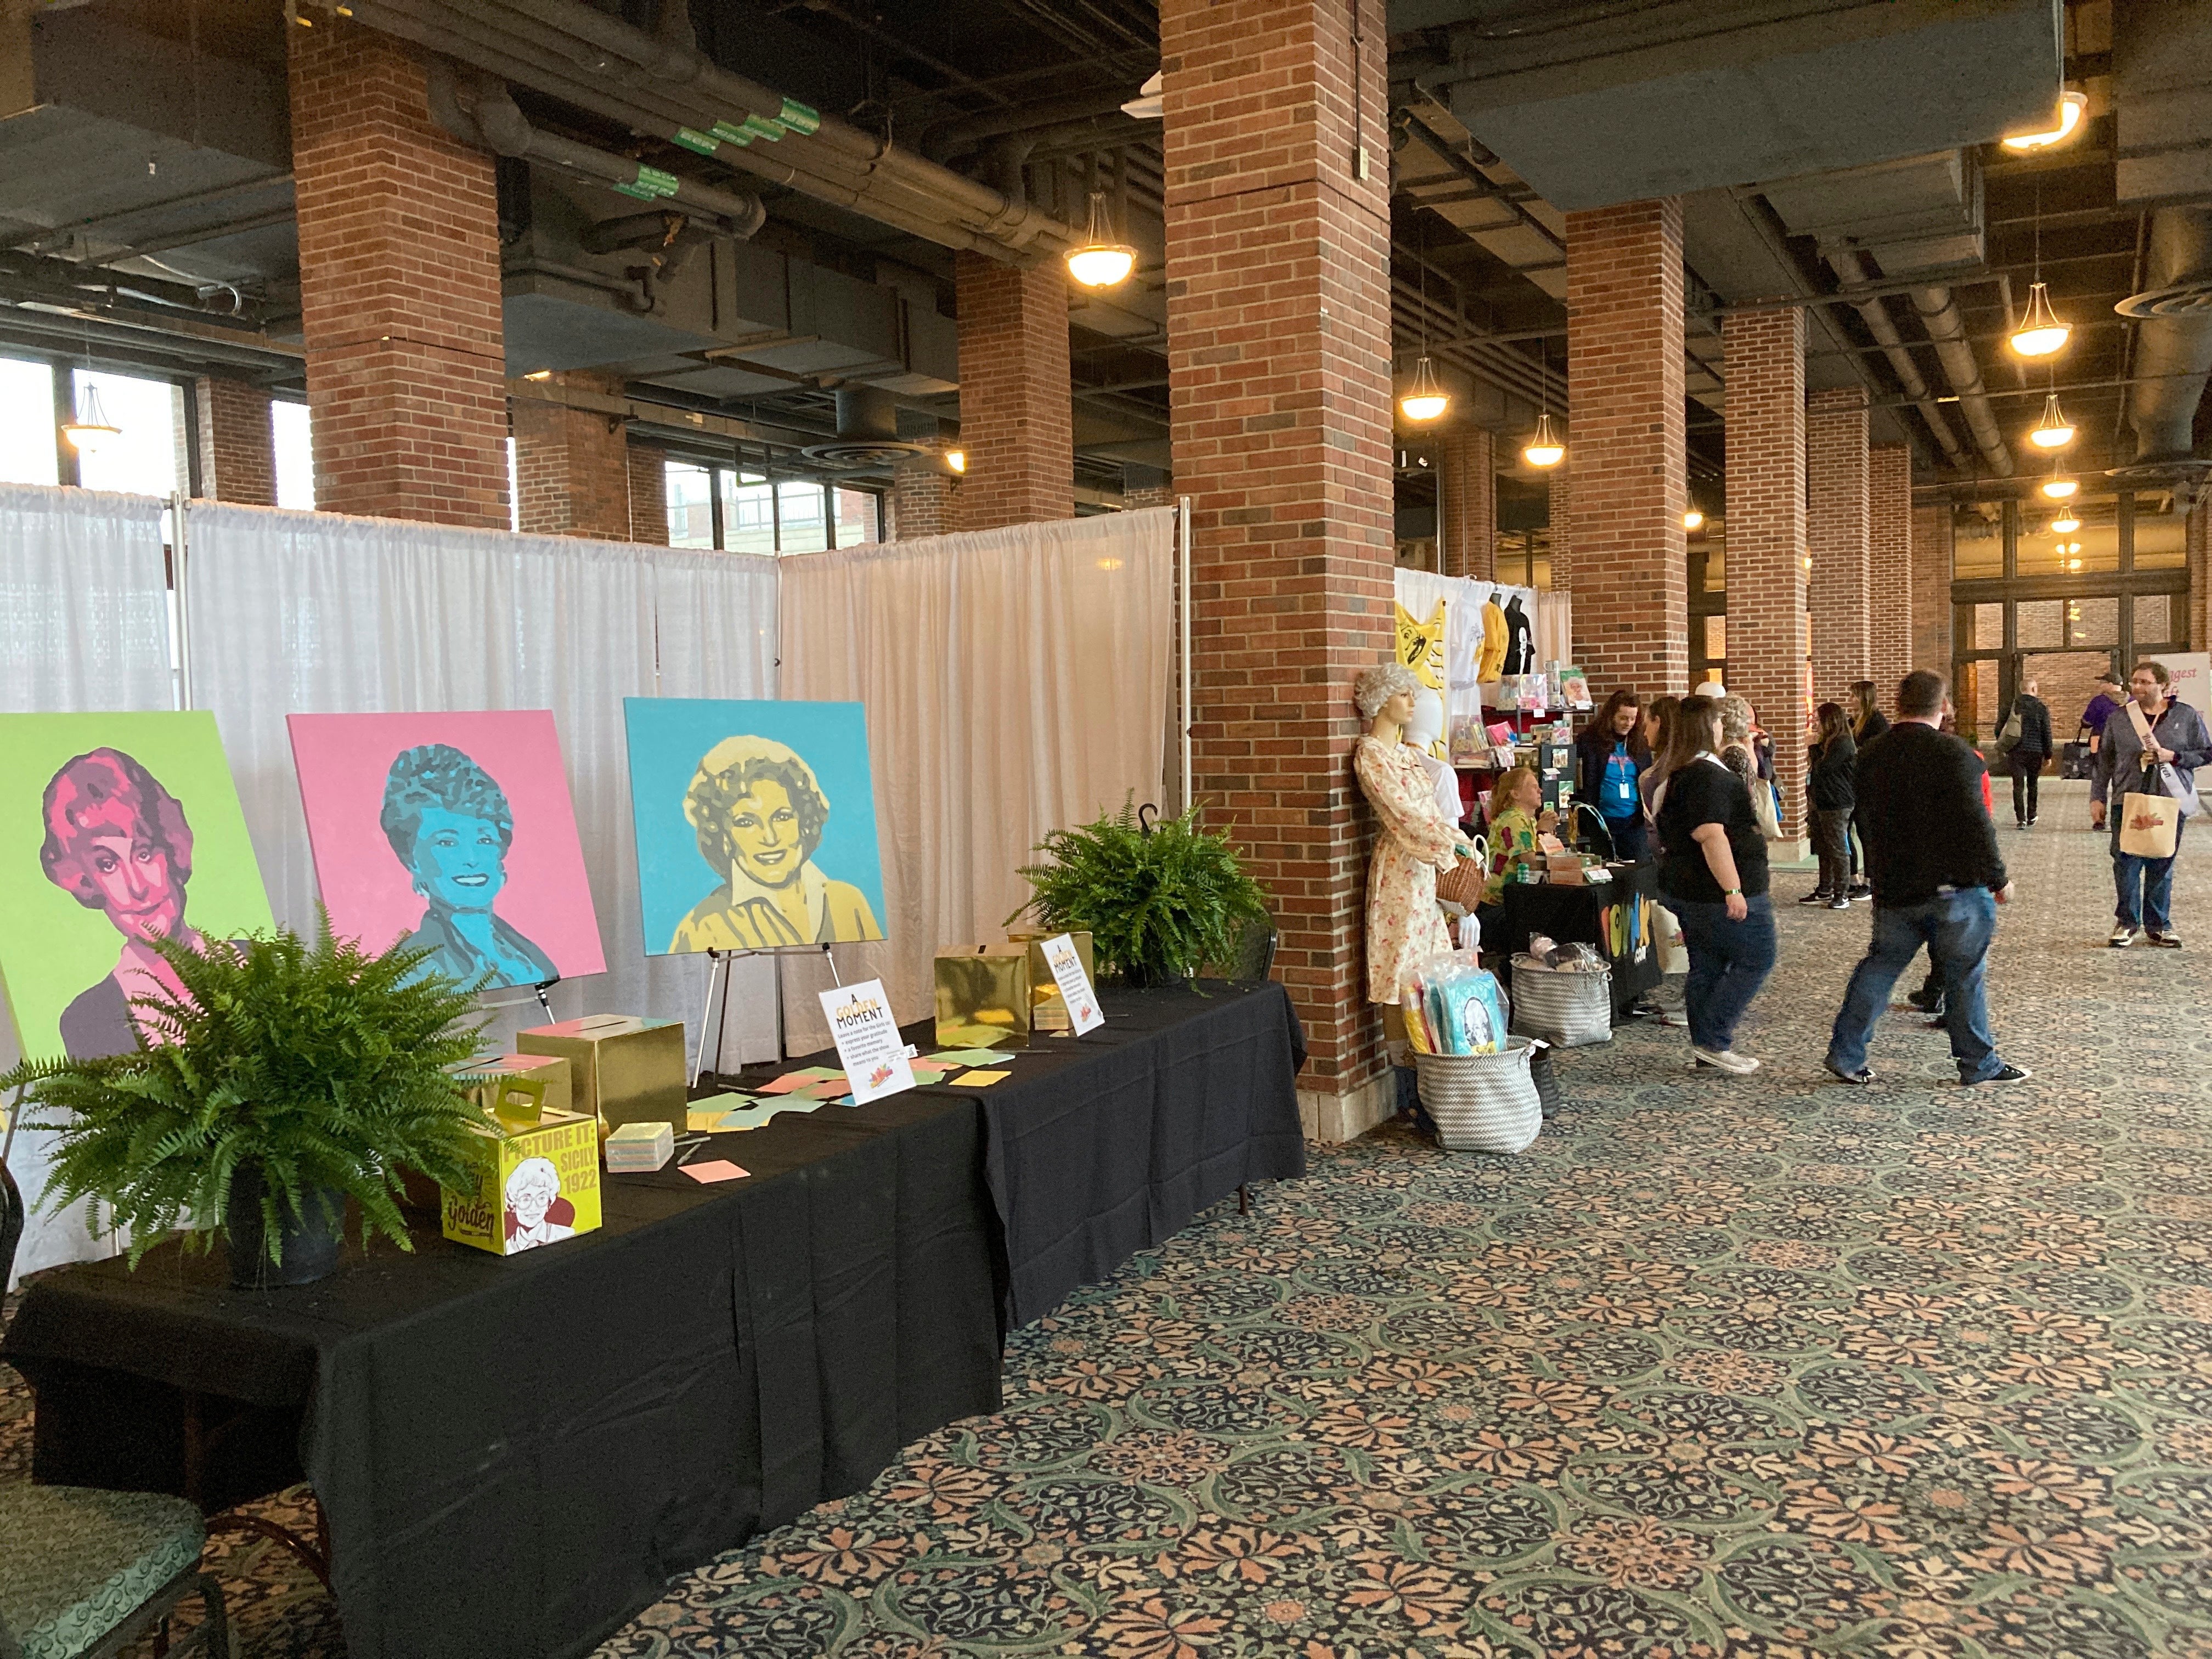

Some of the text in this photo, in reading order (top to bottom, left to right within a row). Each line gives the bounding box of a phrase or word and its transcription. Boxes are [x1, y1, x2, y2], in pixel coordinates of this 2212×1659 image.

[1054, 957, 1077, 973] MOMENT
[836, 998, 877, 1017] GOLDEN
[851, 994, 857, 1005] A
[837, 1007, 883, 1029] MOMENT
[845, 1036, 861, 1045] express
[870, 1029, 888, 1040] gratitude
[851, 1043, 866, 1052] favorite
[867, 1039, 883, 1048] memory
[504, 1124, 595, 1163] PICTURE IT:
[561, 1146, 596, 1172] SICILY,
[565, 1169, 596, 1194] 1922
[448, 1195, 495, 1244] Golden
